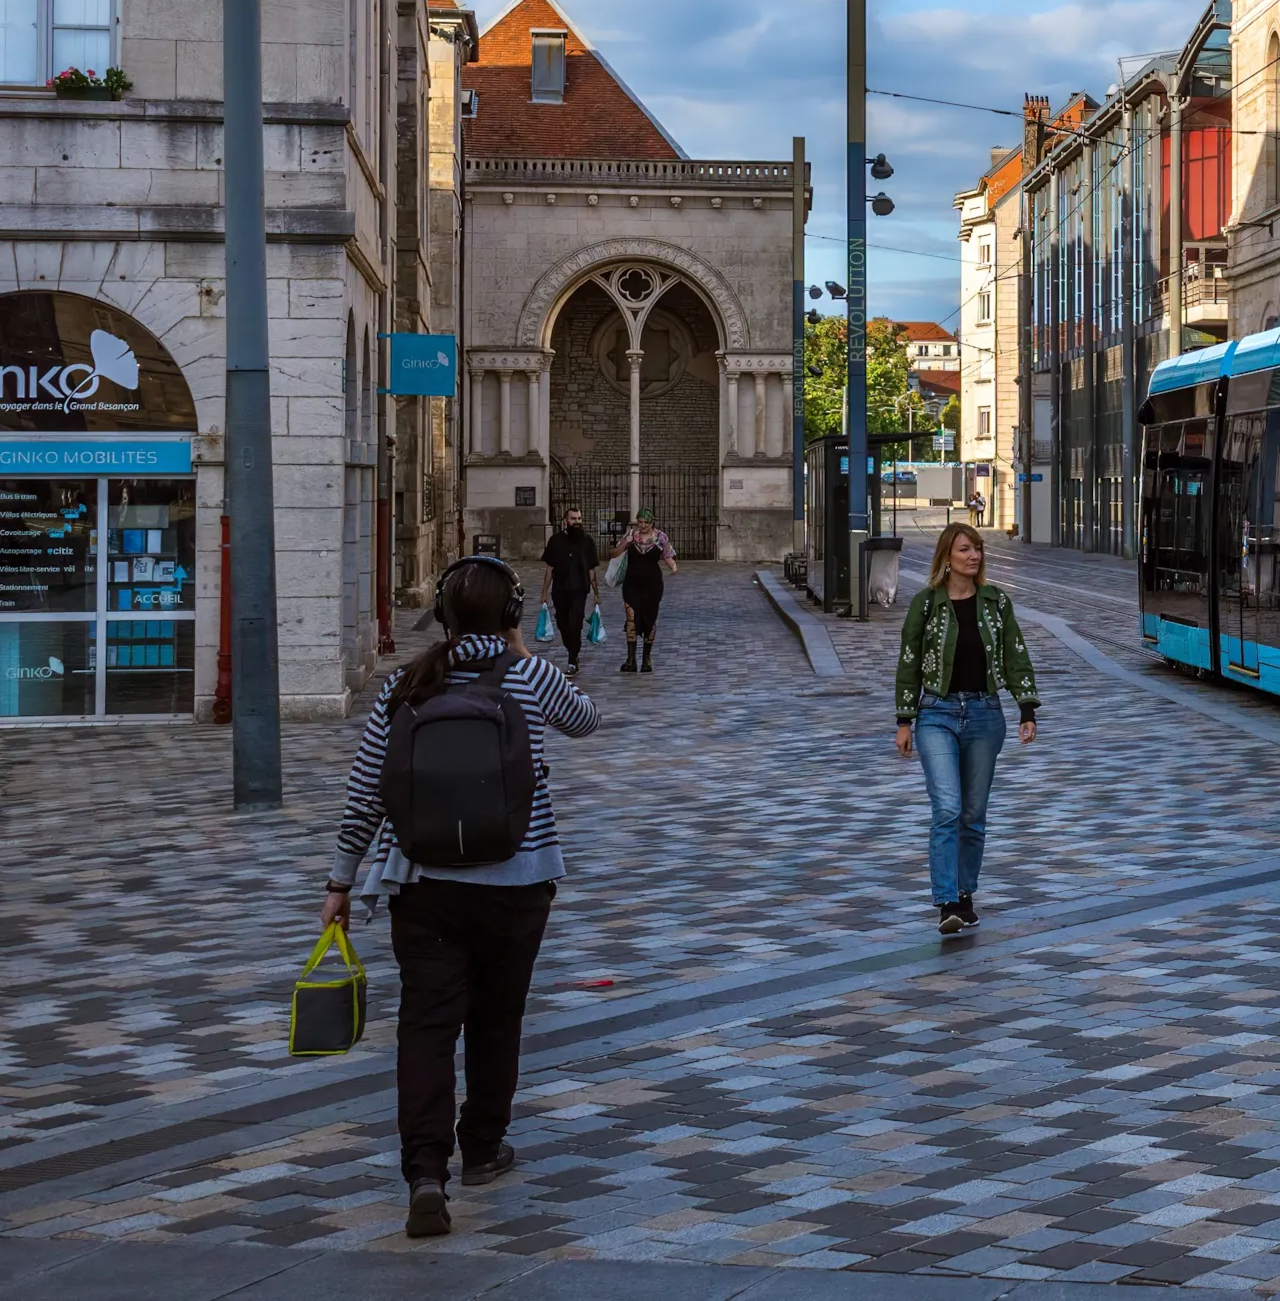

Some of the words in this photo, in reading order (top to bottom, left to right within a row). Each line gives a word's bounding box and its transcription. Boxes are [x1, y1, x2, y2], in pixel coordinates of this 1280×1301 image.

[851, 238, 865, 362] REVOLUTION
[32, 402, 53, 410] dans
[55, 402, 63, 410] le
[69, 402, 97, 410] Grand
[98, 402, 139, 412] Besançon
[1, 451, 59, 464] GINKO
[64, 449, 158, 464] MOBILITÉS
[53, 547, 73, 555] citiz
[133, 594, 184, 604] ACCUEIL
